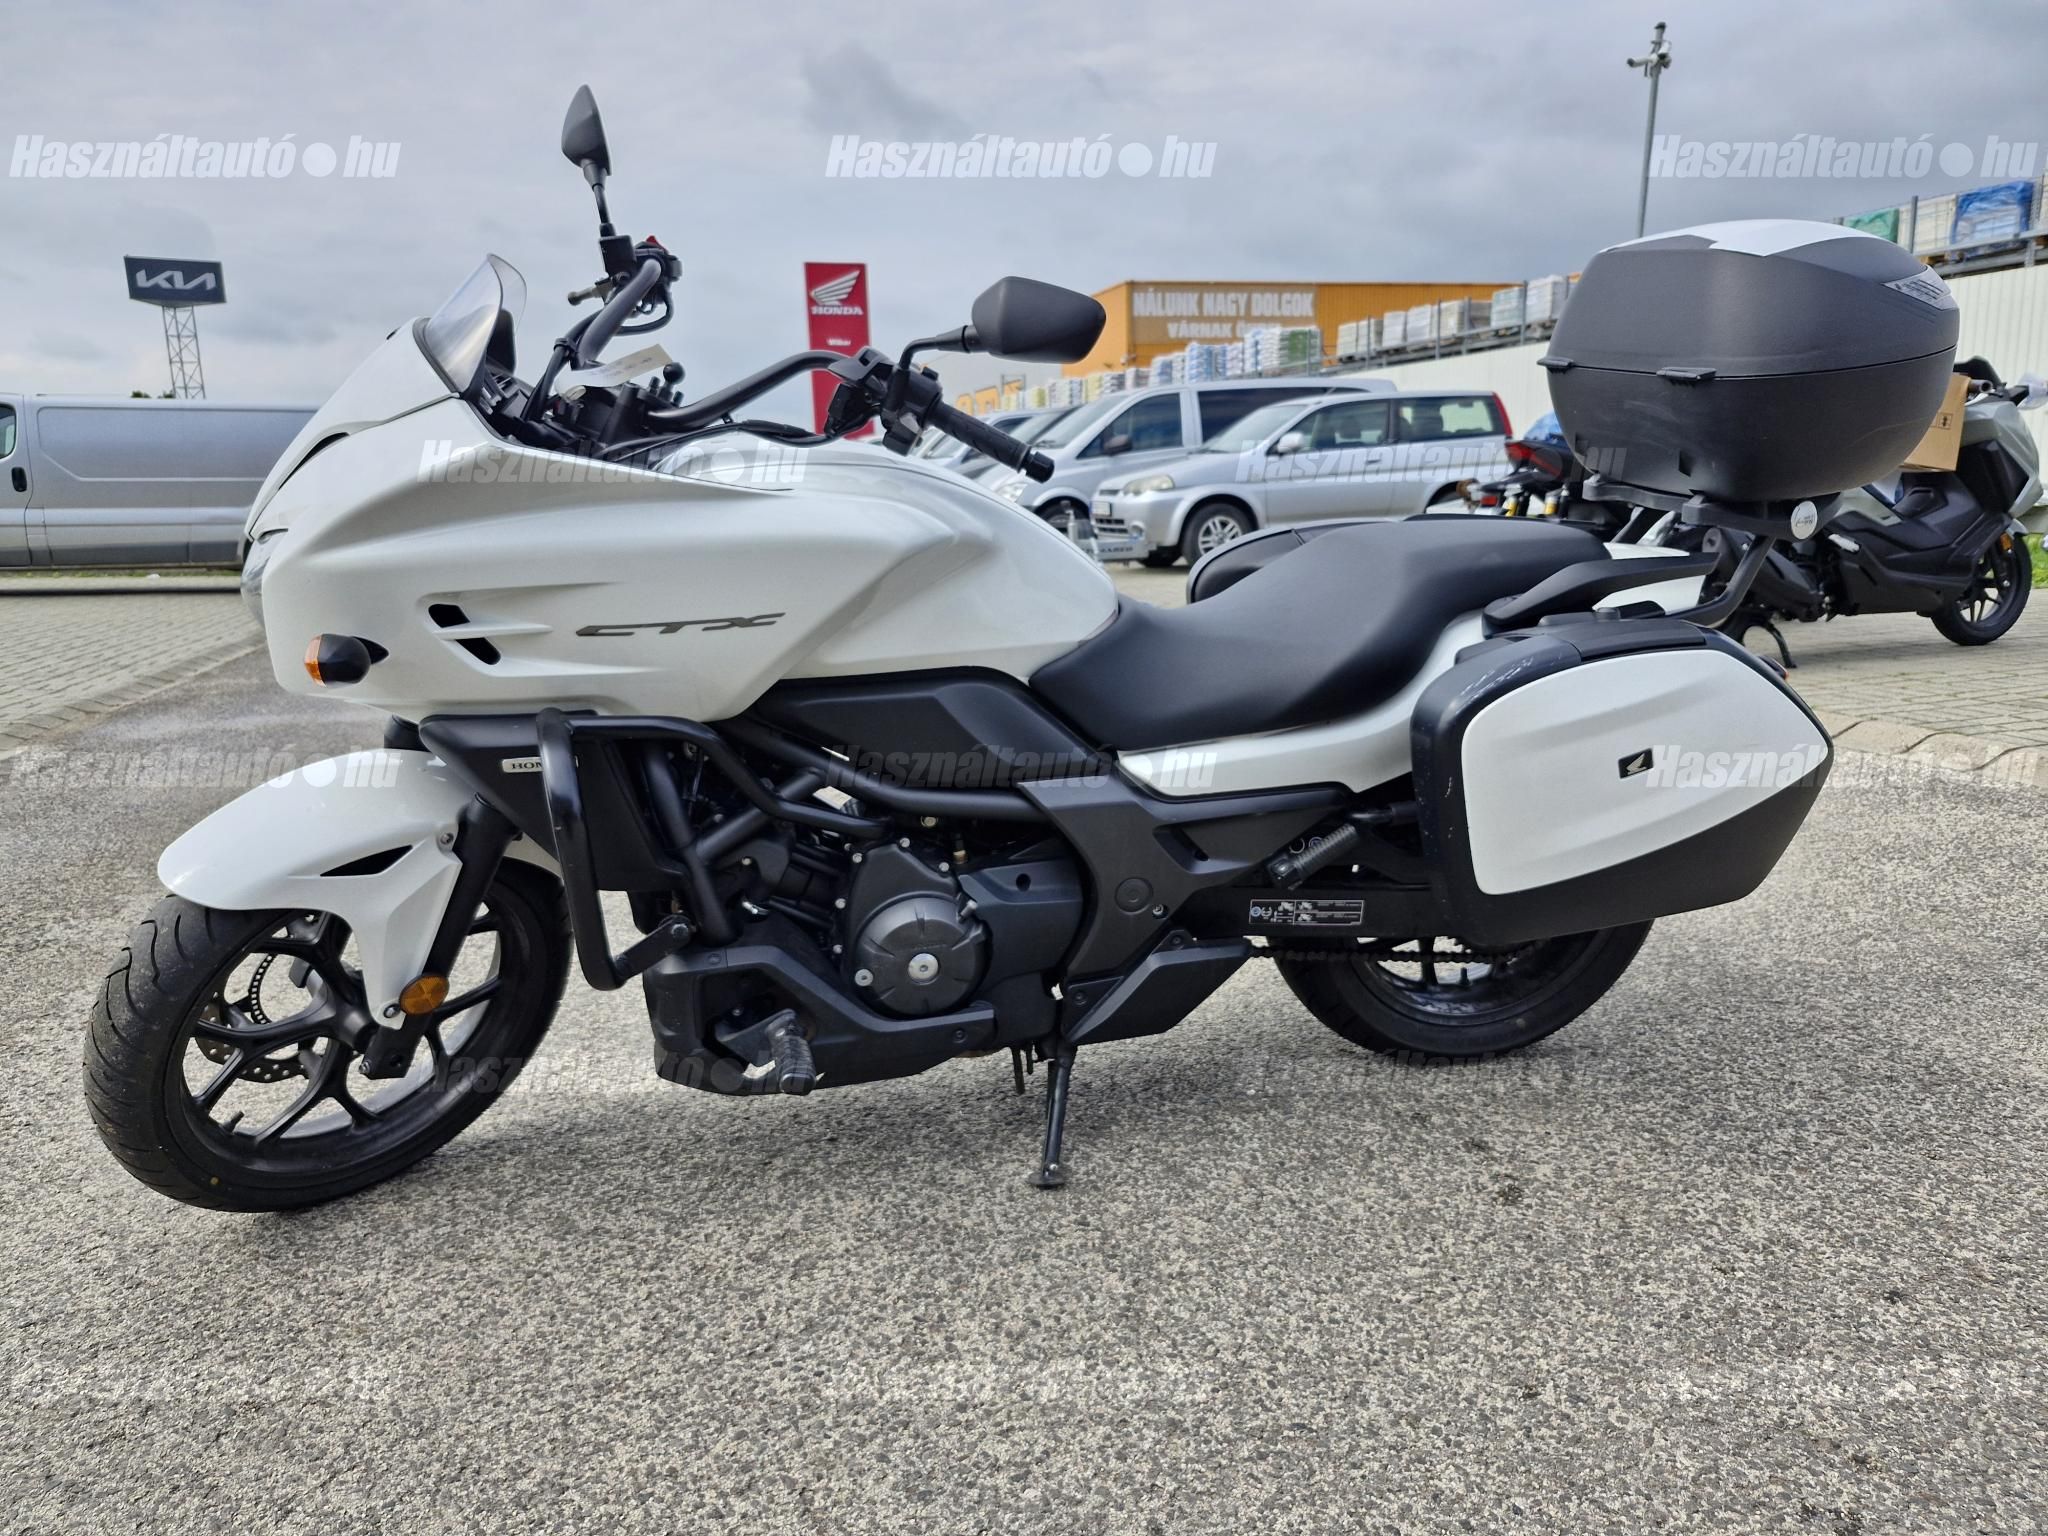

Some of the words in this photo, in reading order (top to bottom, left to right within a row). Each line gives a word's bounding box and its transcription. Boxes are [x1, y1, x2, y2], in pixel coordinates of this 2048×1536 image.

[136, 269, 216, 290] KIA
[811, 306, 864, 315] HONDA
[1133, 287, 1199, 317] NÁLUNK
[1202, 292, 1248, 317] NAGY
[1251, 292, 1314, 317] DOLGOK
[575, 612, 786, 636] CTX
